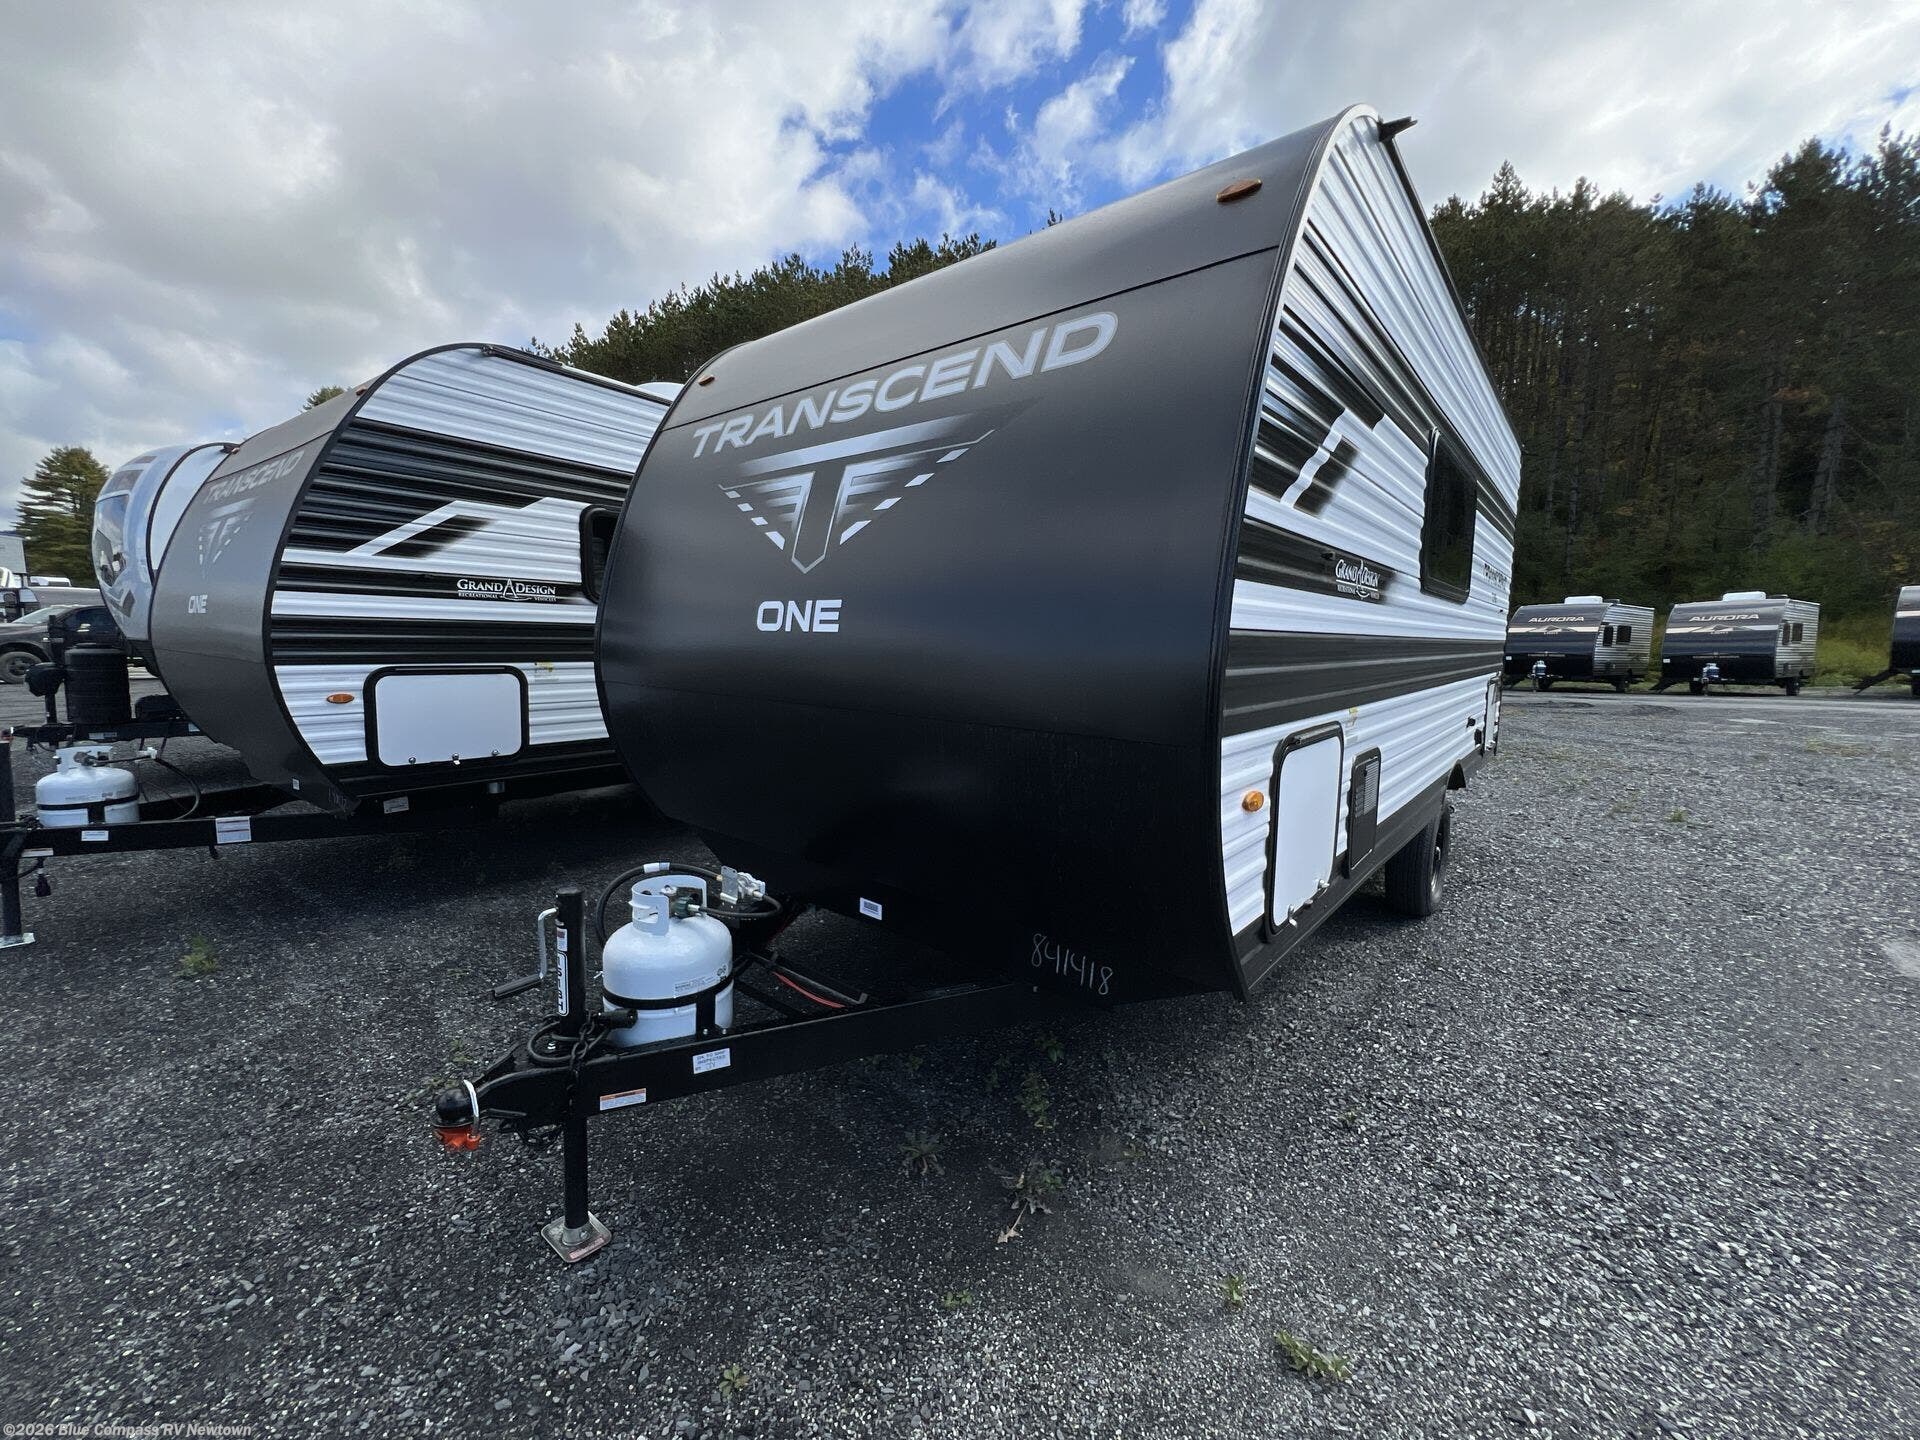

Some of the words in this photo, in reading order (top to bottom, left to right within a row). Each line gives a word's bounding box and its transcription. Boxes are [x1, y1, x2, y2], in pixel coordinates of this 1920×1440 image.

[692, 311, 1119, 459] TRANSCEND
[203, 450, 305, 504] TRANSCEND
[457, 578, 503, 592] GRAND
[516, 582, 556, 595] DESIGN
[188, 594, 208, 614] ONE
[756, 599, 842, 633] ONE
[1688, 613, 1760, 622] AURORA
[1031, 933, 1113, 995] 841418
